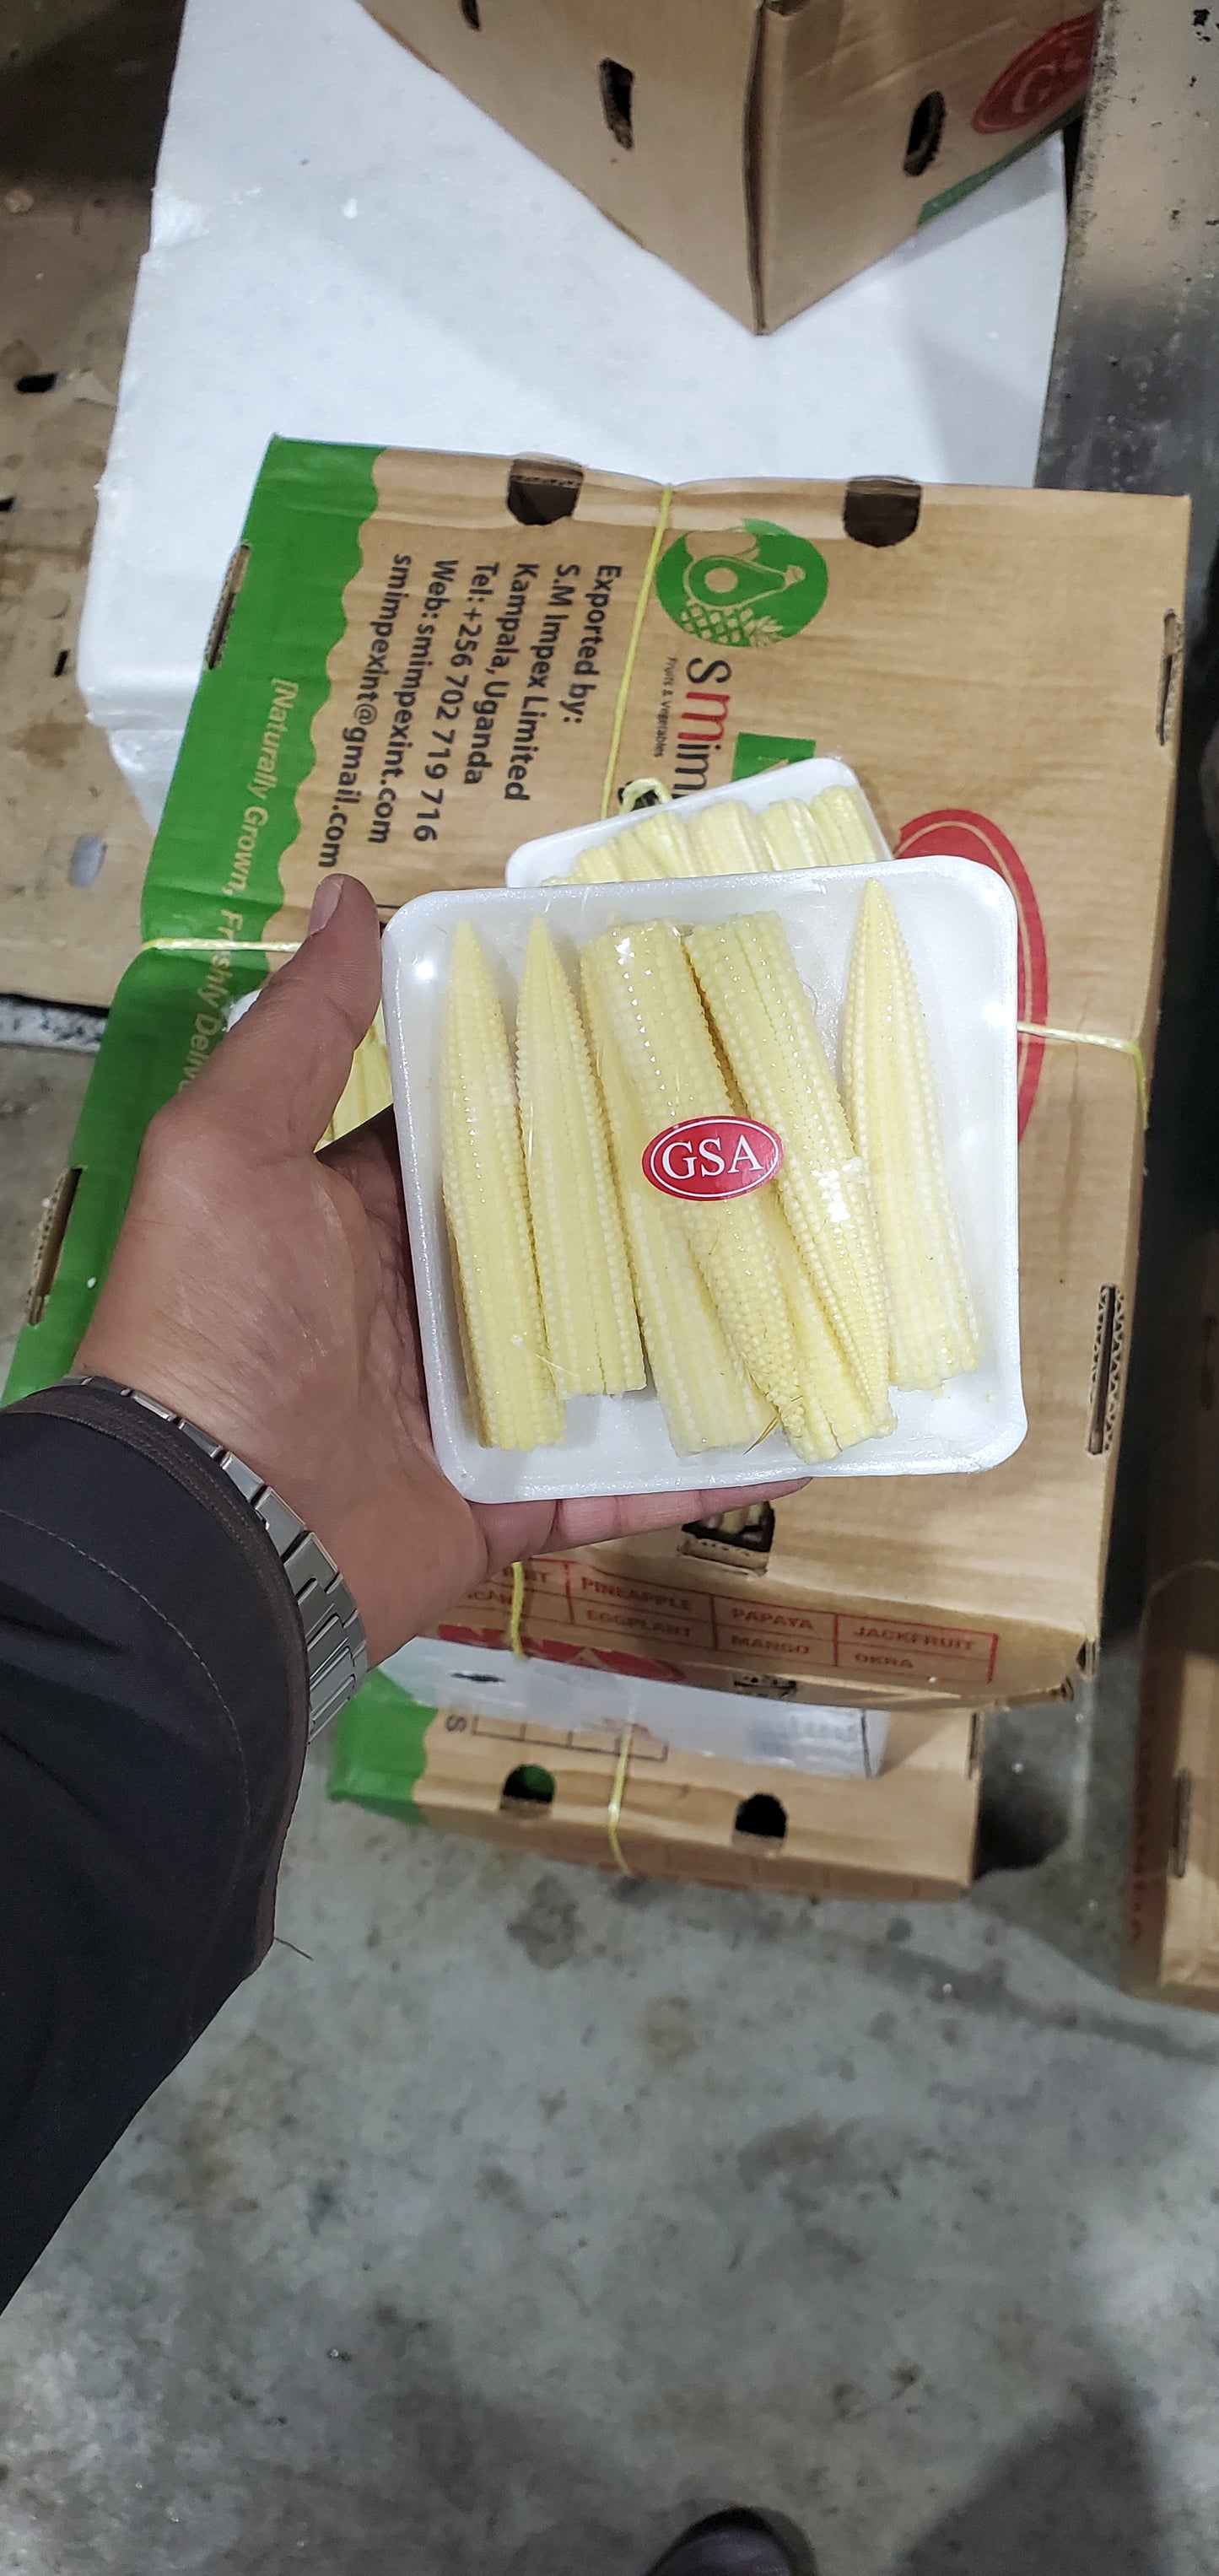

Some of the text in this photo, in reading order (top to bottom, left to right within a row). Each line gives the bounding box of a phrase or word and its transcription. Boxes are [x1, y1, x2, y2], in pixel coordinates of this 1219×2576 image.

[464, 563, 539, 784] Kampala, Uganda
[504, 564, 580, 800] S.M Impex Limited
[559, 565, 622, 723] Exported by:
[247, 677, 299, 800] [Naturally
[319, 554, 412, 867] smimpexint@gmail.com
[368, 622, 434, 843] smimpexint.com
[413, 563, 499, 842] Tel: +256 702 719 716
[222, 806, 268, 895] Grown,
[197, 908, 244, 1007] Frshly
[662, 1134, 764, 1180] GSA
[581, 1576, 690, 1610] PINEAPPLE
[587, 1609, 690, 1637] EGGPLANT
[732, 1608, 813, 1630] PAPAYA
[853, 1626, 975, 1652] JACKFRUIT
[731, 1635, 810, 1655] MANGO
[854, 1652, 913, 1669] OKRA
